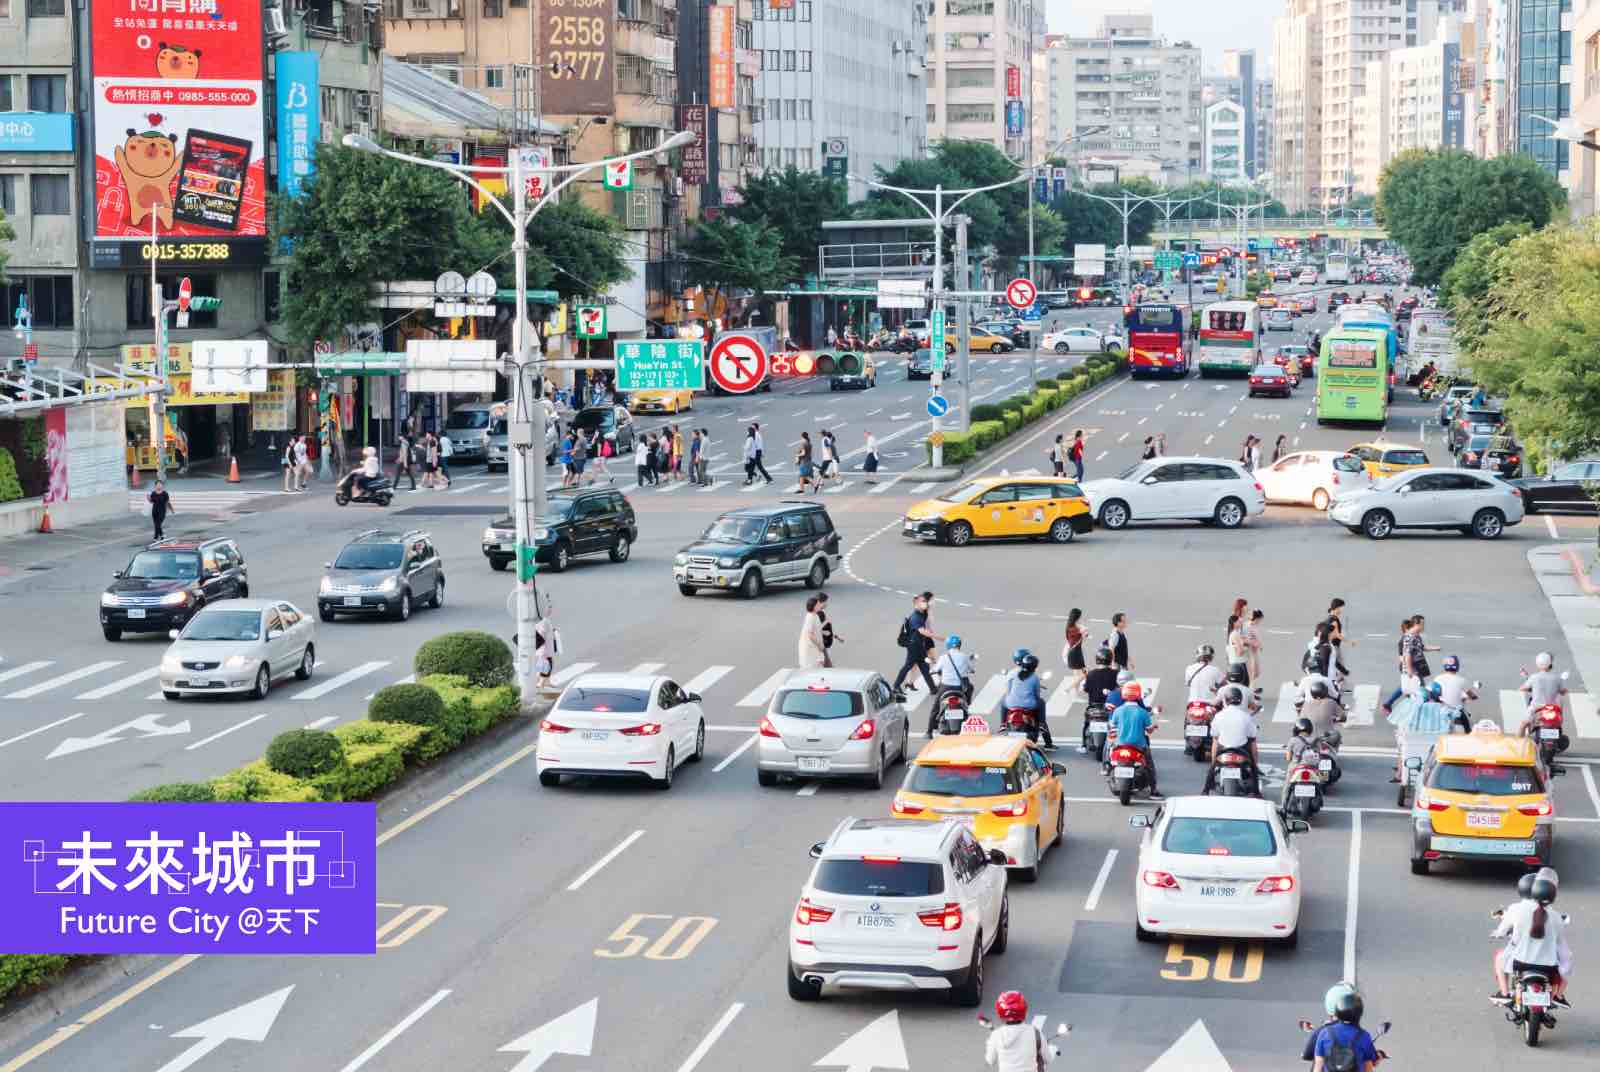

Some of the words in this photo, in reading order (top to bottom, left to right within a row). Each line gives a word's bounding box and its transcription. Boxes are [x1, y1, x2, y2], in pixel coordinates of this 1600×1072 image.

[549, 15, 605, 46] 2558
[142, 244, 229, 259] 0915-357388
[593, 913, 720, 961] 50
[1160, 943, 1265, 984] 50
